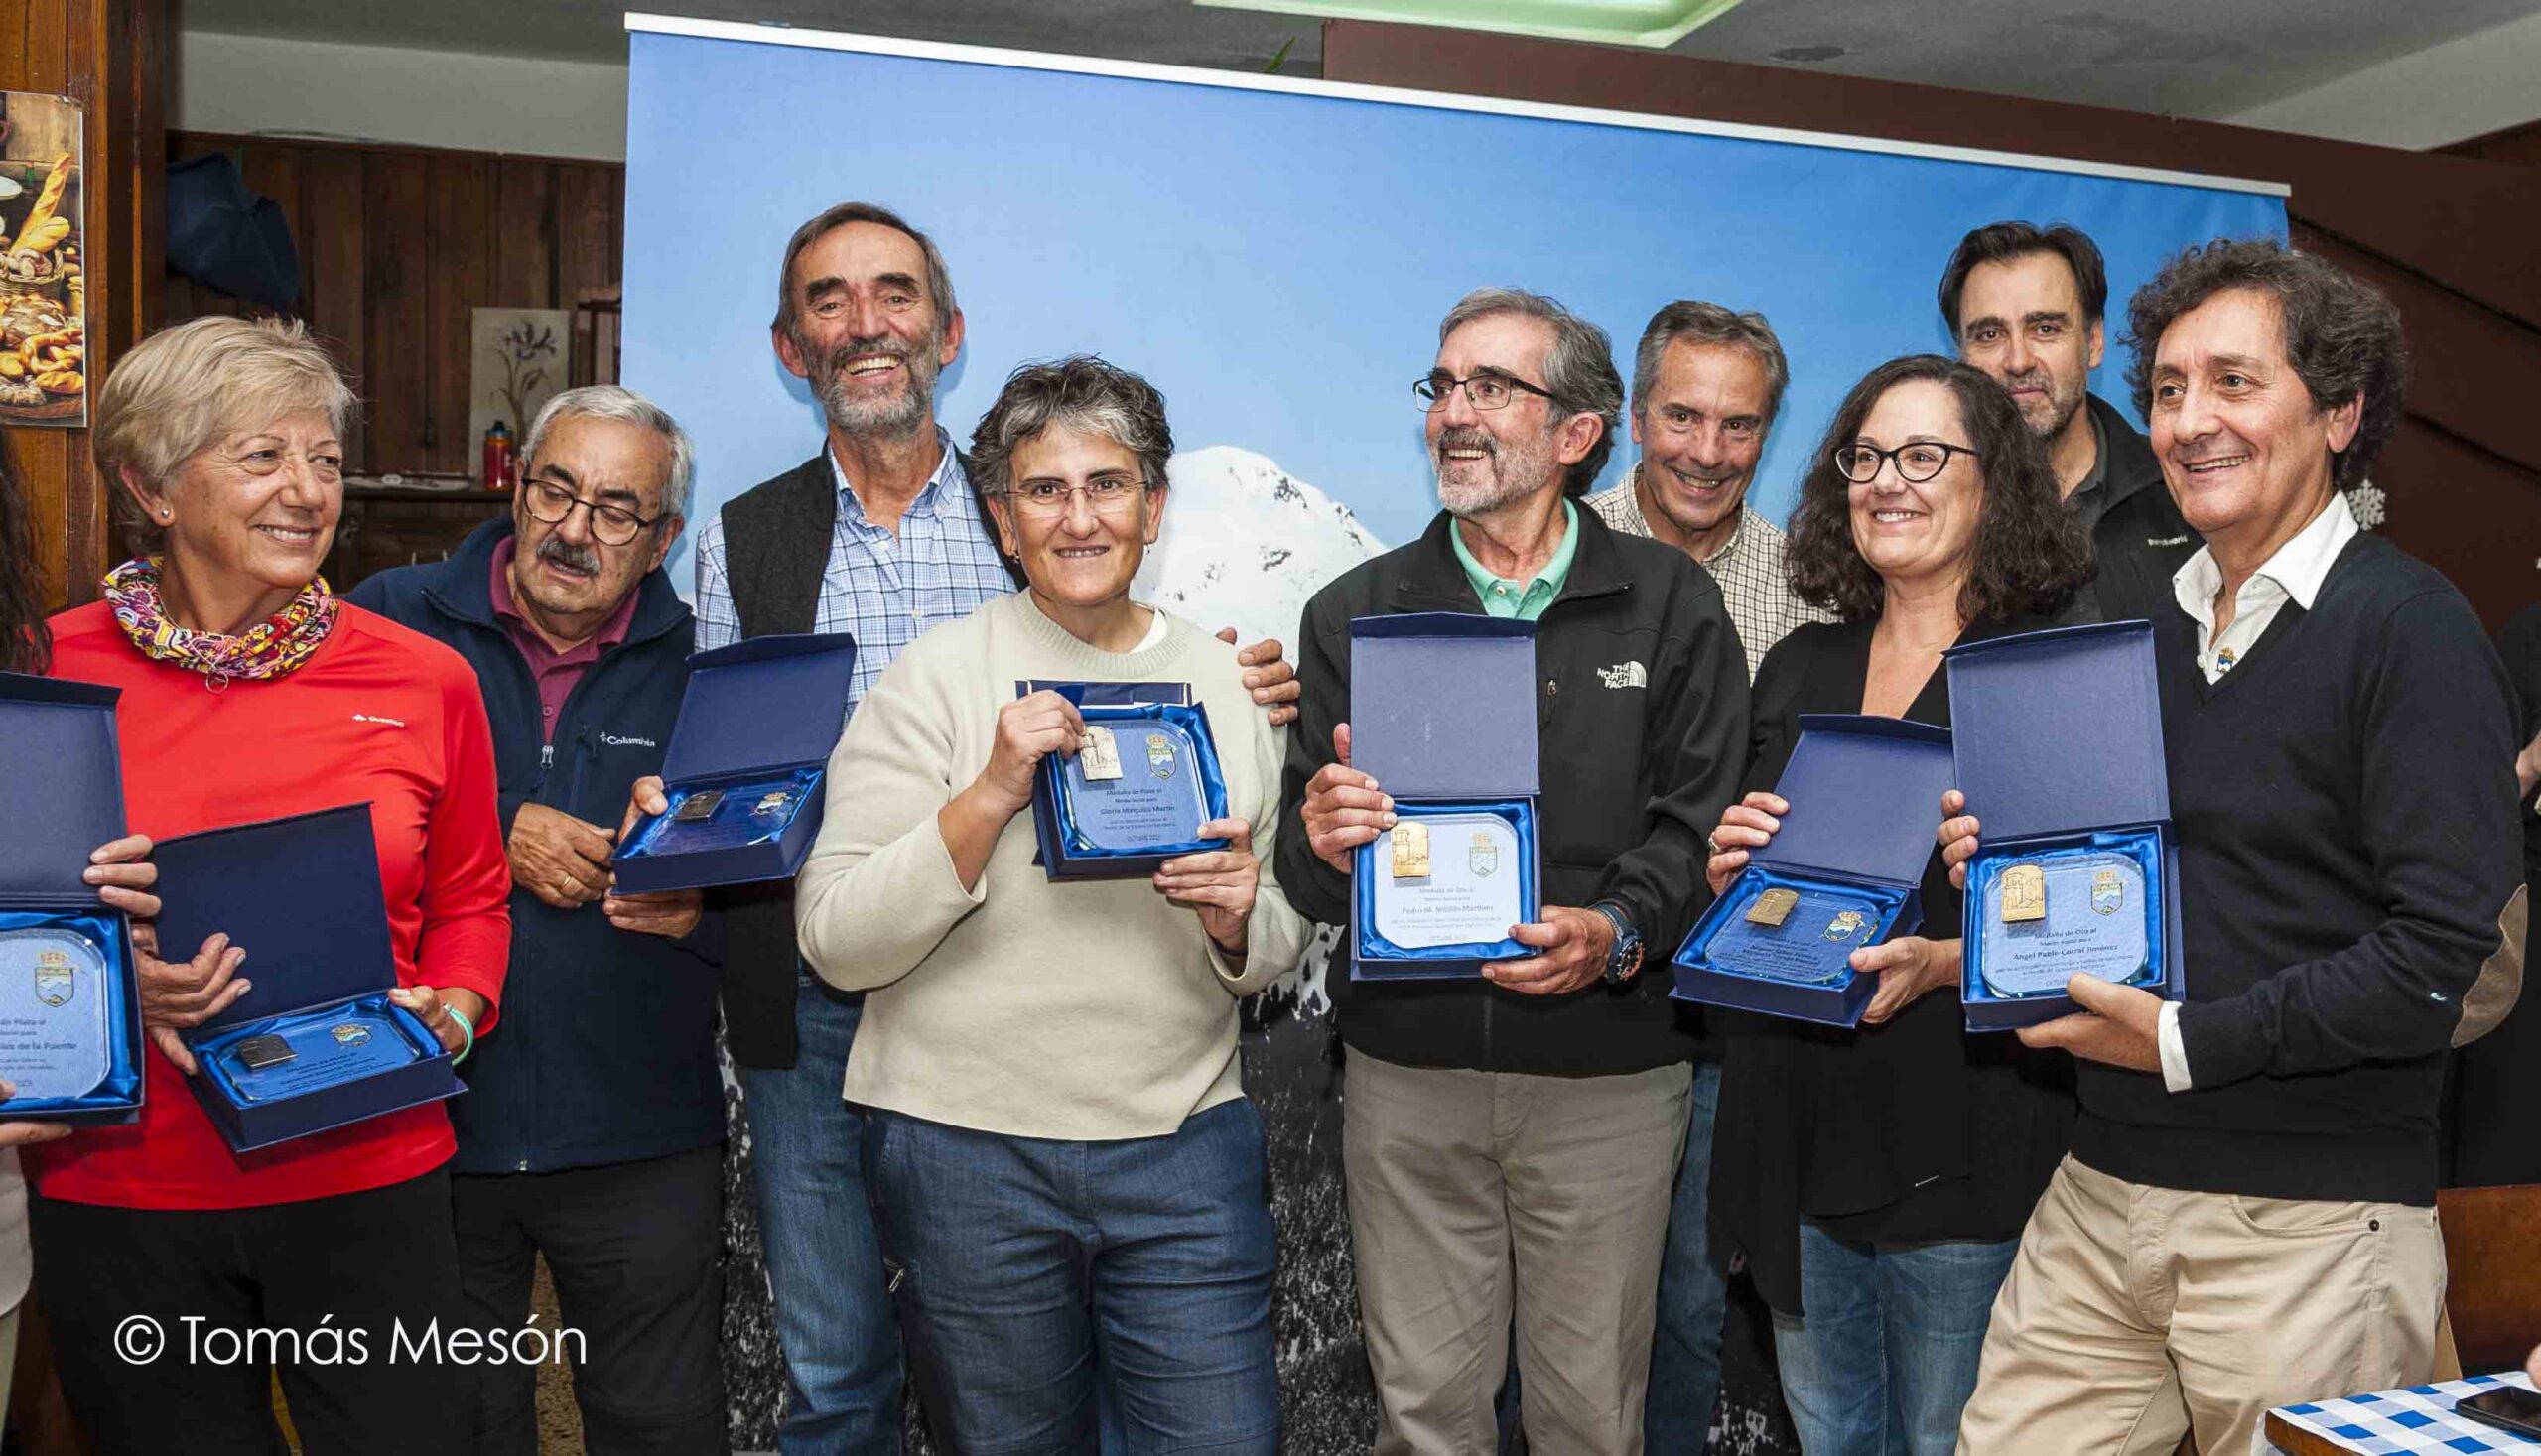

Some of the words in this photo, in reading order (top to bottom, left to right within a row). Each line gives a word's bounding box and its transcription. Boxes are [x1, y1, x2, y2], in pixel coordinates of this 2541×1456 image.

[1612, 662, 1629, 673] THE
[1597, 667, 1629, 681] NORTH
[1605, 678, 1629, 689] FACE
[607, 735, 655, 746] Columbia
[2037, 949, 2060, 959] Pablo
